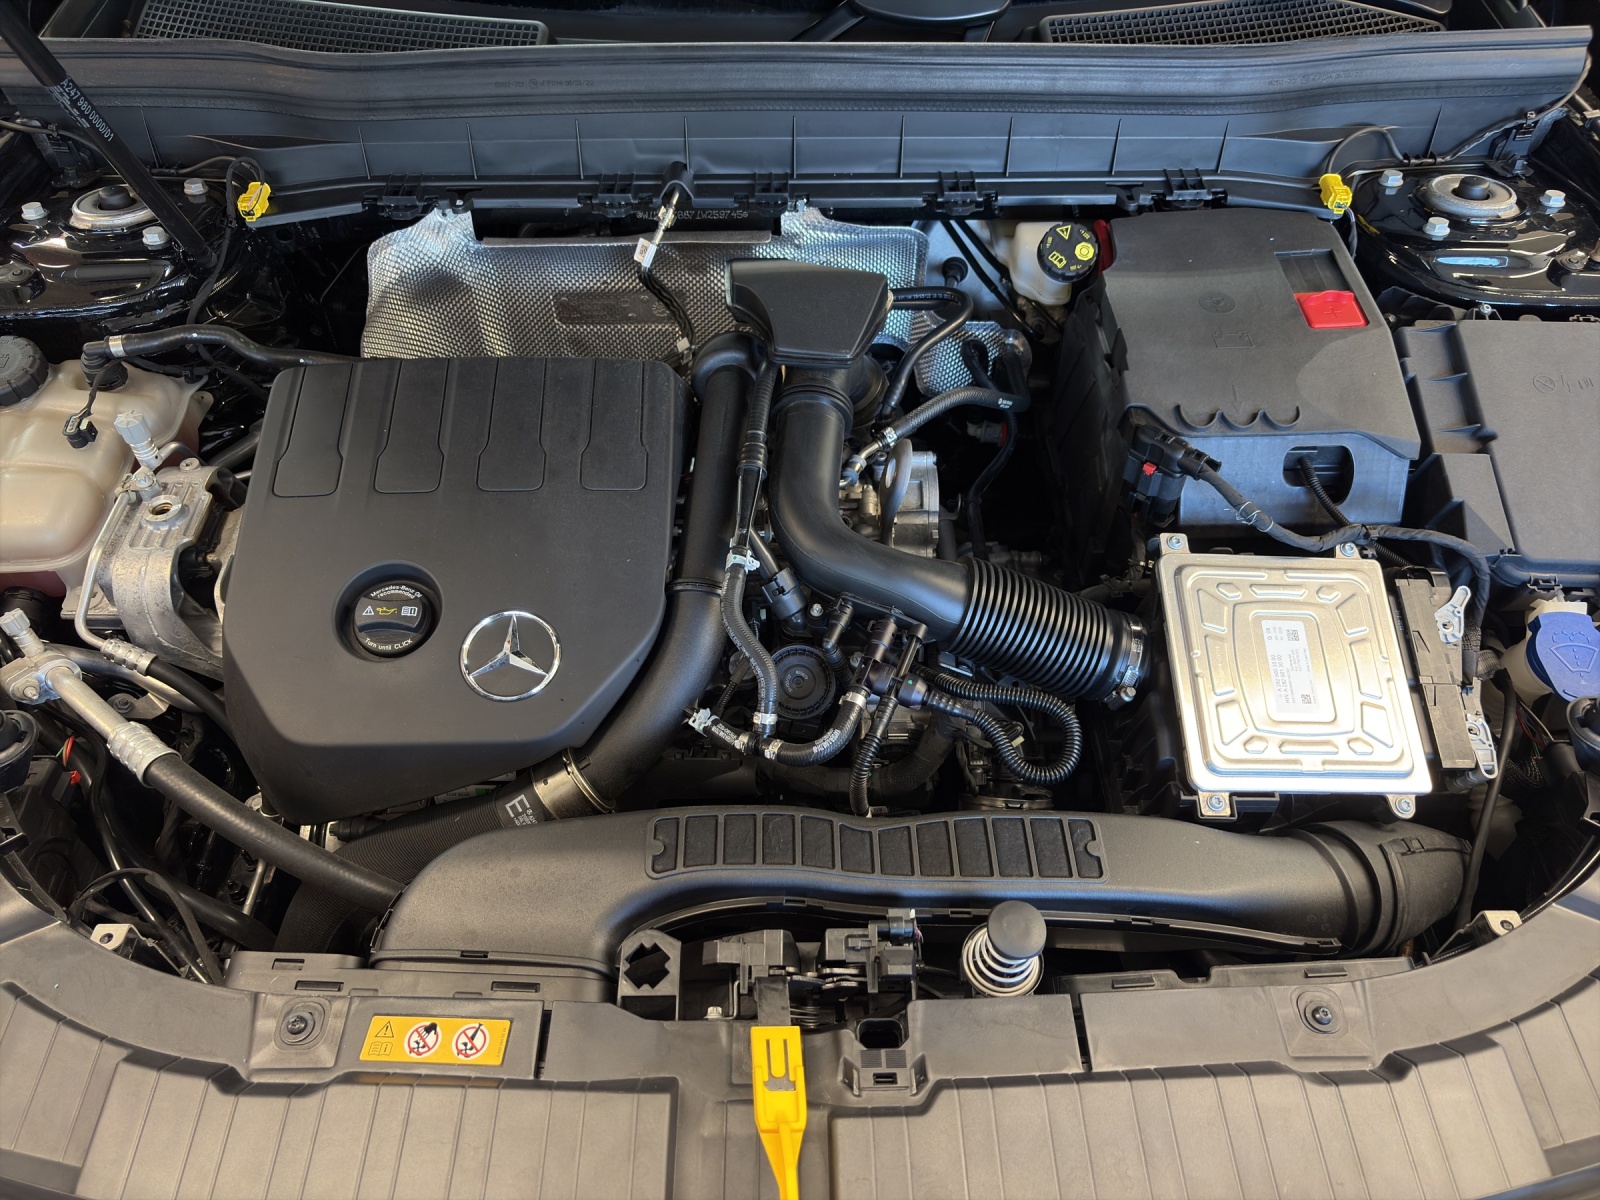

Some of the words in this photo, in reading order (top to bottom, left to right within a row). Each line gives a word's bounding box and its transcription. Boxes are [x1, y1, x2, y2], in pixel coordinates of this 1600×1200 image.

[60, 78, 80, 100] A247
[78, 96, 92, 114] 980
[88, 110, 114, 142] 0000/01
[370, 585, 415, 597] Mercedes-Benz
[377, 590, 415, 599] recommended
[365, 638, 377, 648] Turn
[394, 638, 413, 649] CLICK
[505, 794, 530, 817] E
